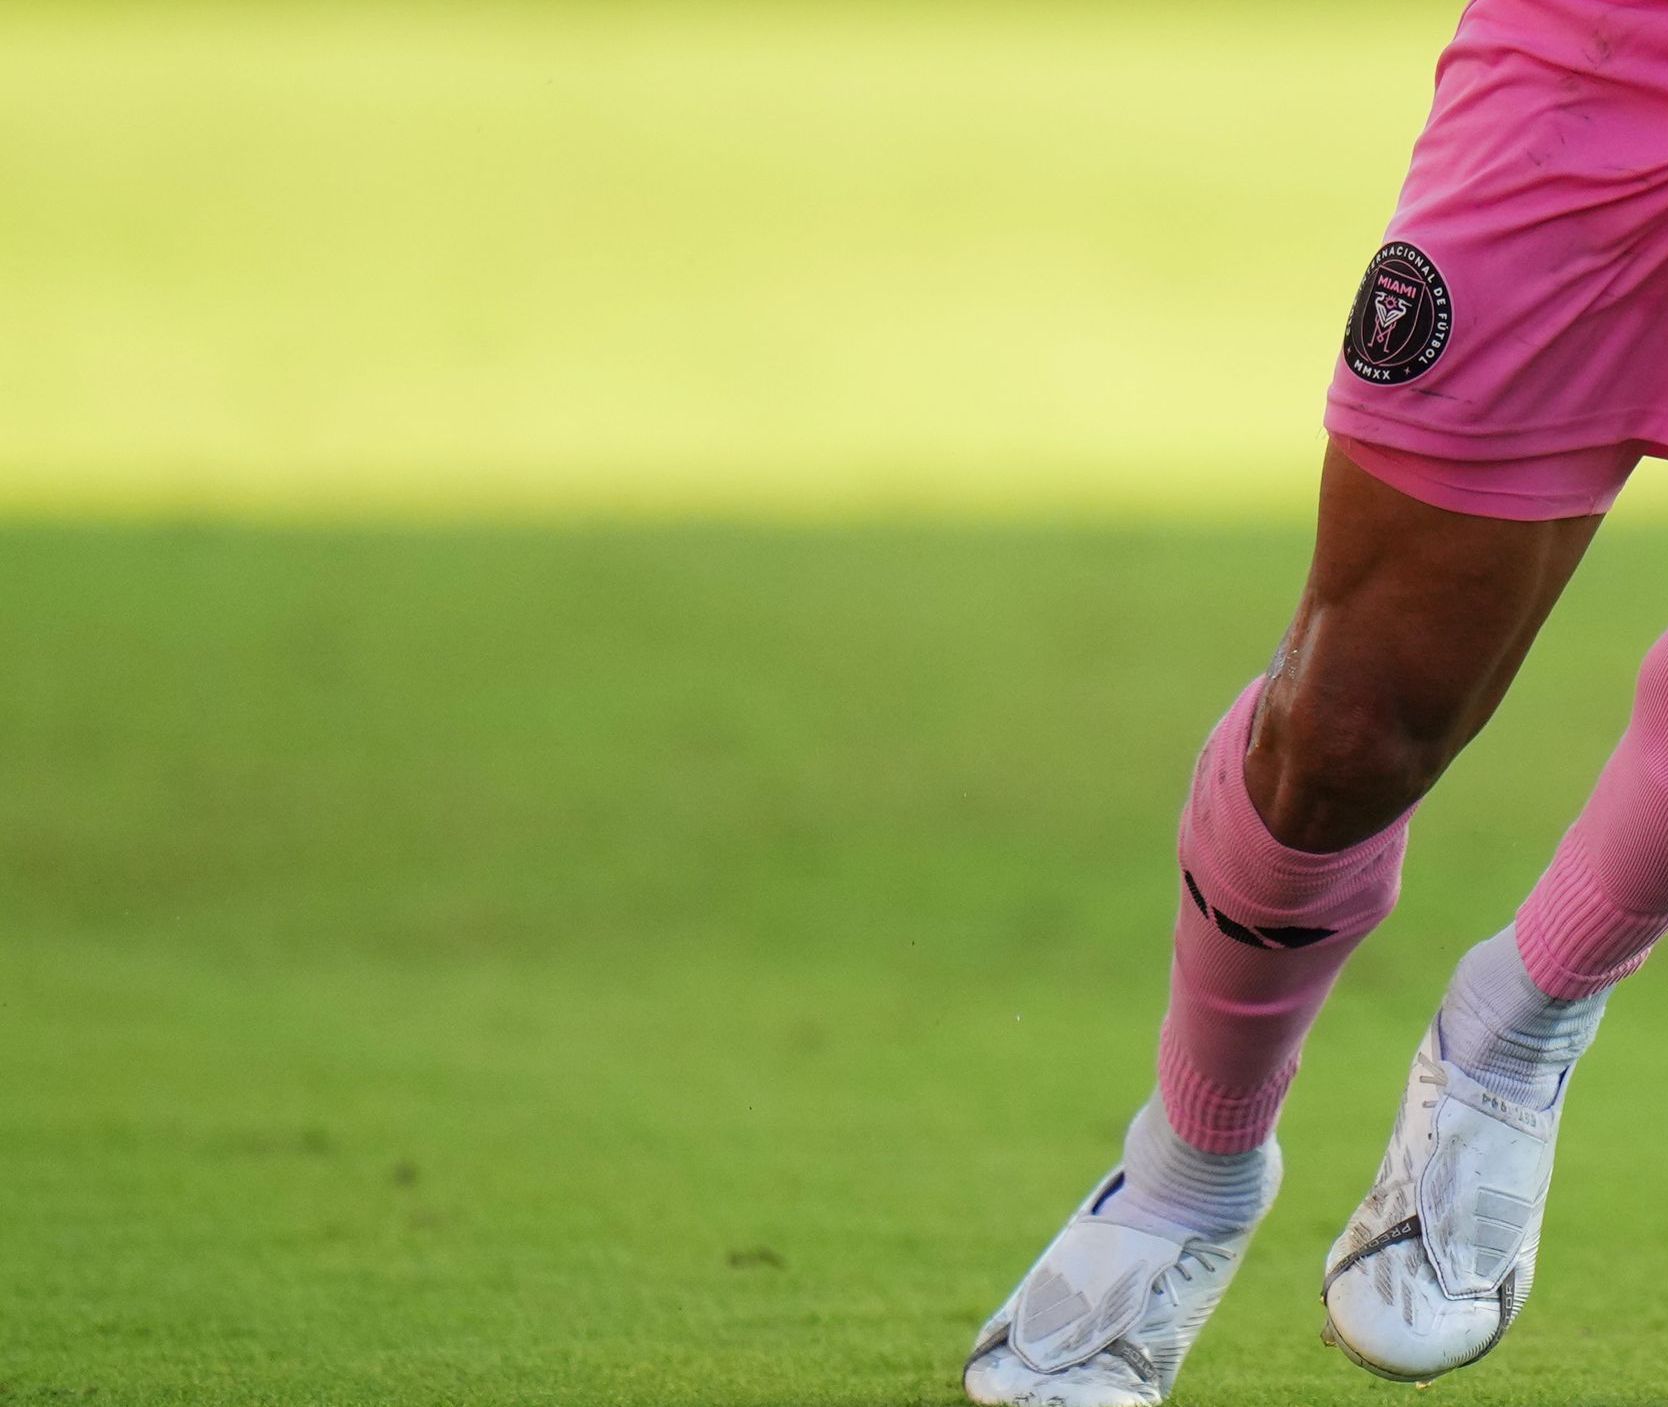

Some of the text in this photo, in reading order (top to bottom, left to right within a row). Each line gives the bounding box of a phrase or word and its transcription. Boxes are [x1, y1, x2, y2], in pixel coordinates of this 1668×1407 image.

[1377, 275, 1417, 299] MIAMI
[1433, 287, 1447, 306] DE
[1353, 359, 1391, 381] MMXX
